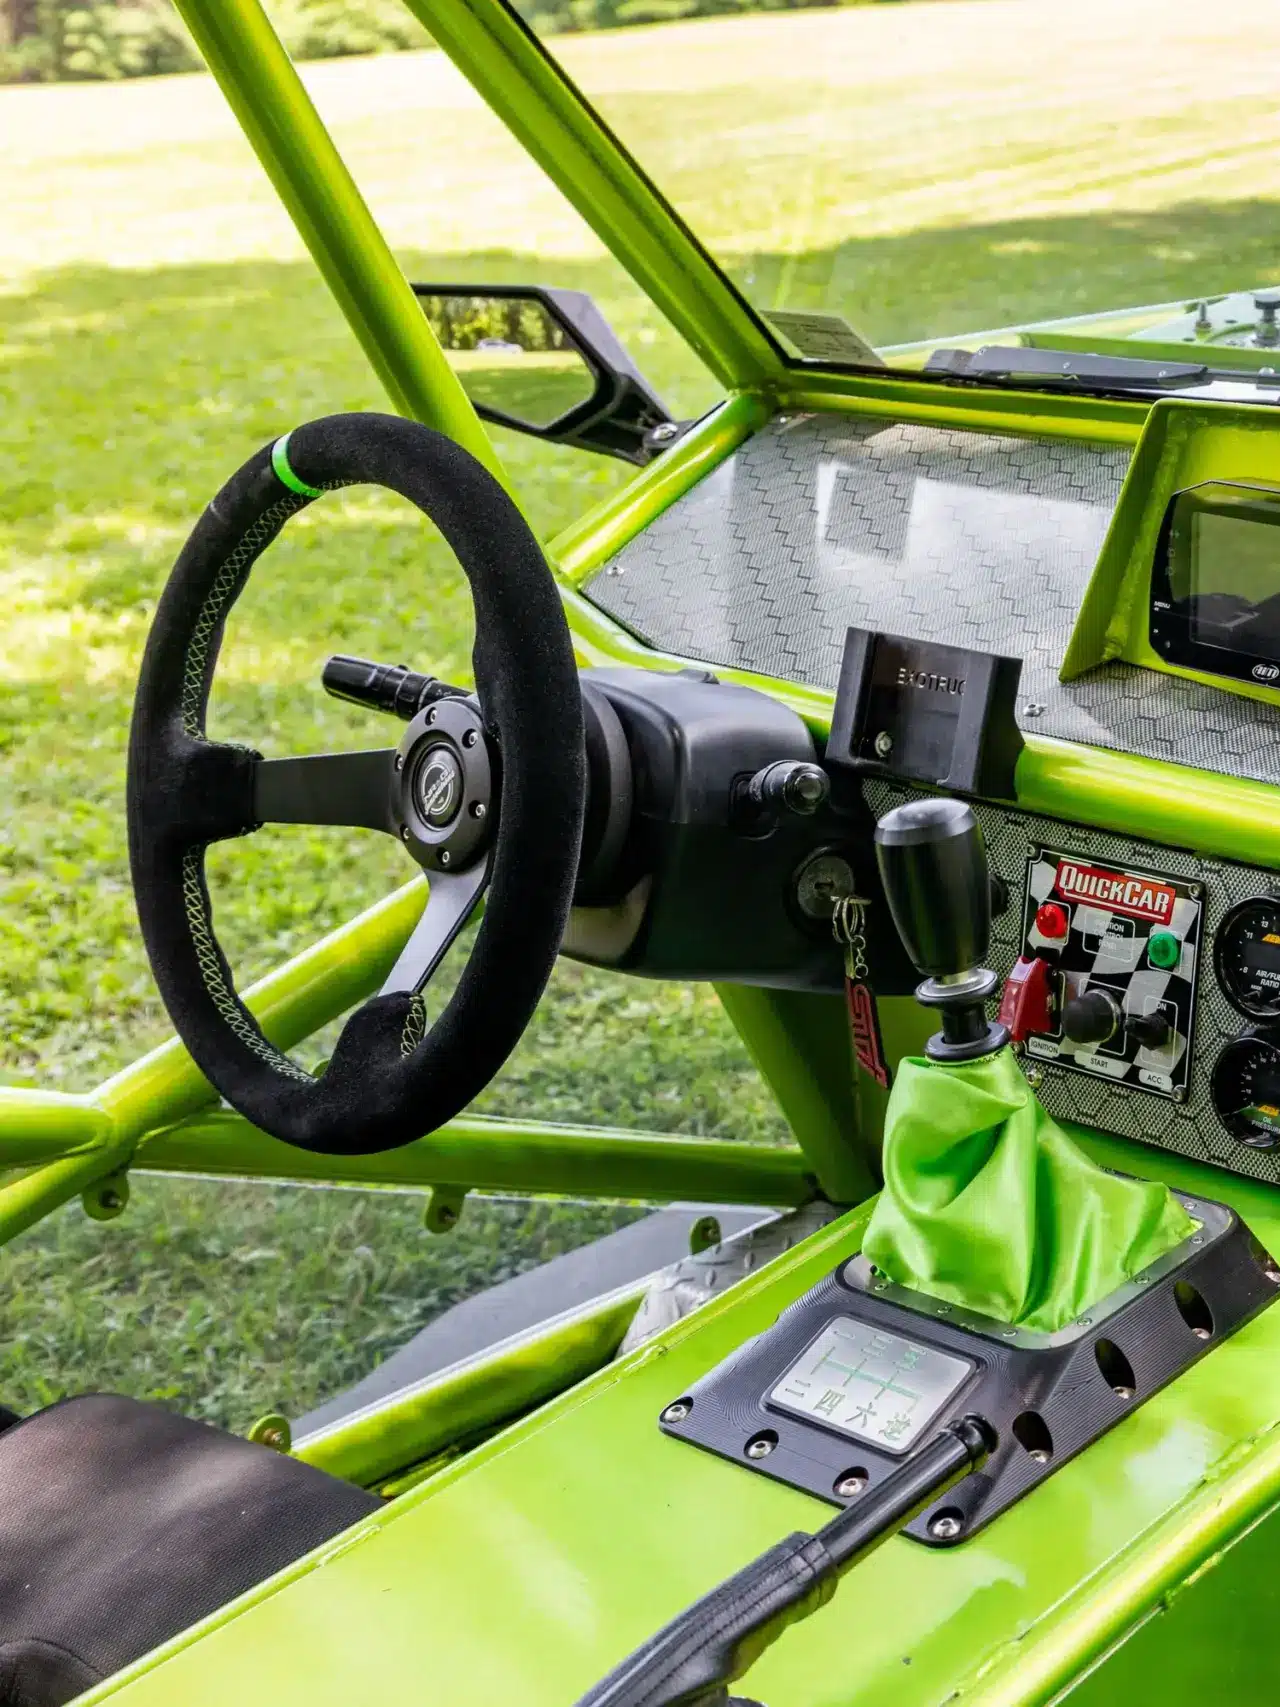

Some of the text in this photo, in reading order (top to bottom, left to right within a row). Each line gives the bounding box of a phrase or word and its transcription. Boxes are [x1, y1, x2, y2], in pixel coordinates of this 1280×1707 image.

[1261, 920, 1269, 928] 13
[1246, 932, 1254, 940] 11
[1260, 978, 1280, 989] RATIO
[1030, 1041, 1058, 1054] IGNITION
[1090, 1057, 1109, 1069] START
[785, 1379, 812, 1398] 二
[813, 1389, 846, 1416] 四
[845, 1401, 878, 1429] 六
